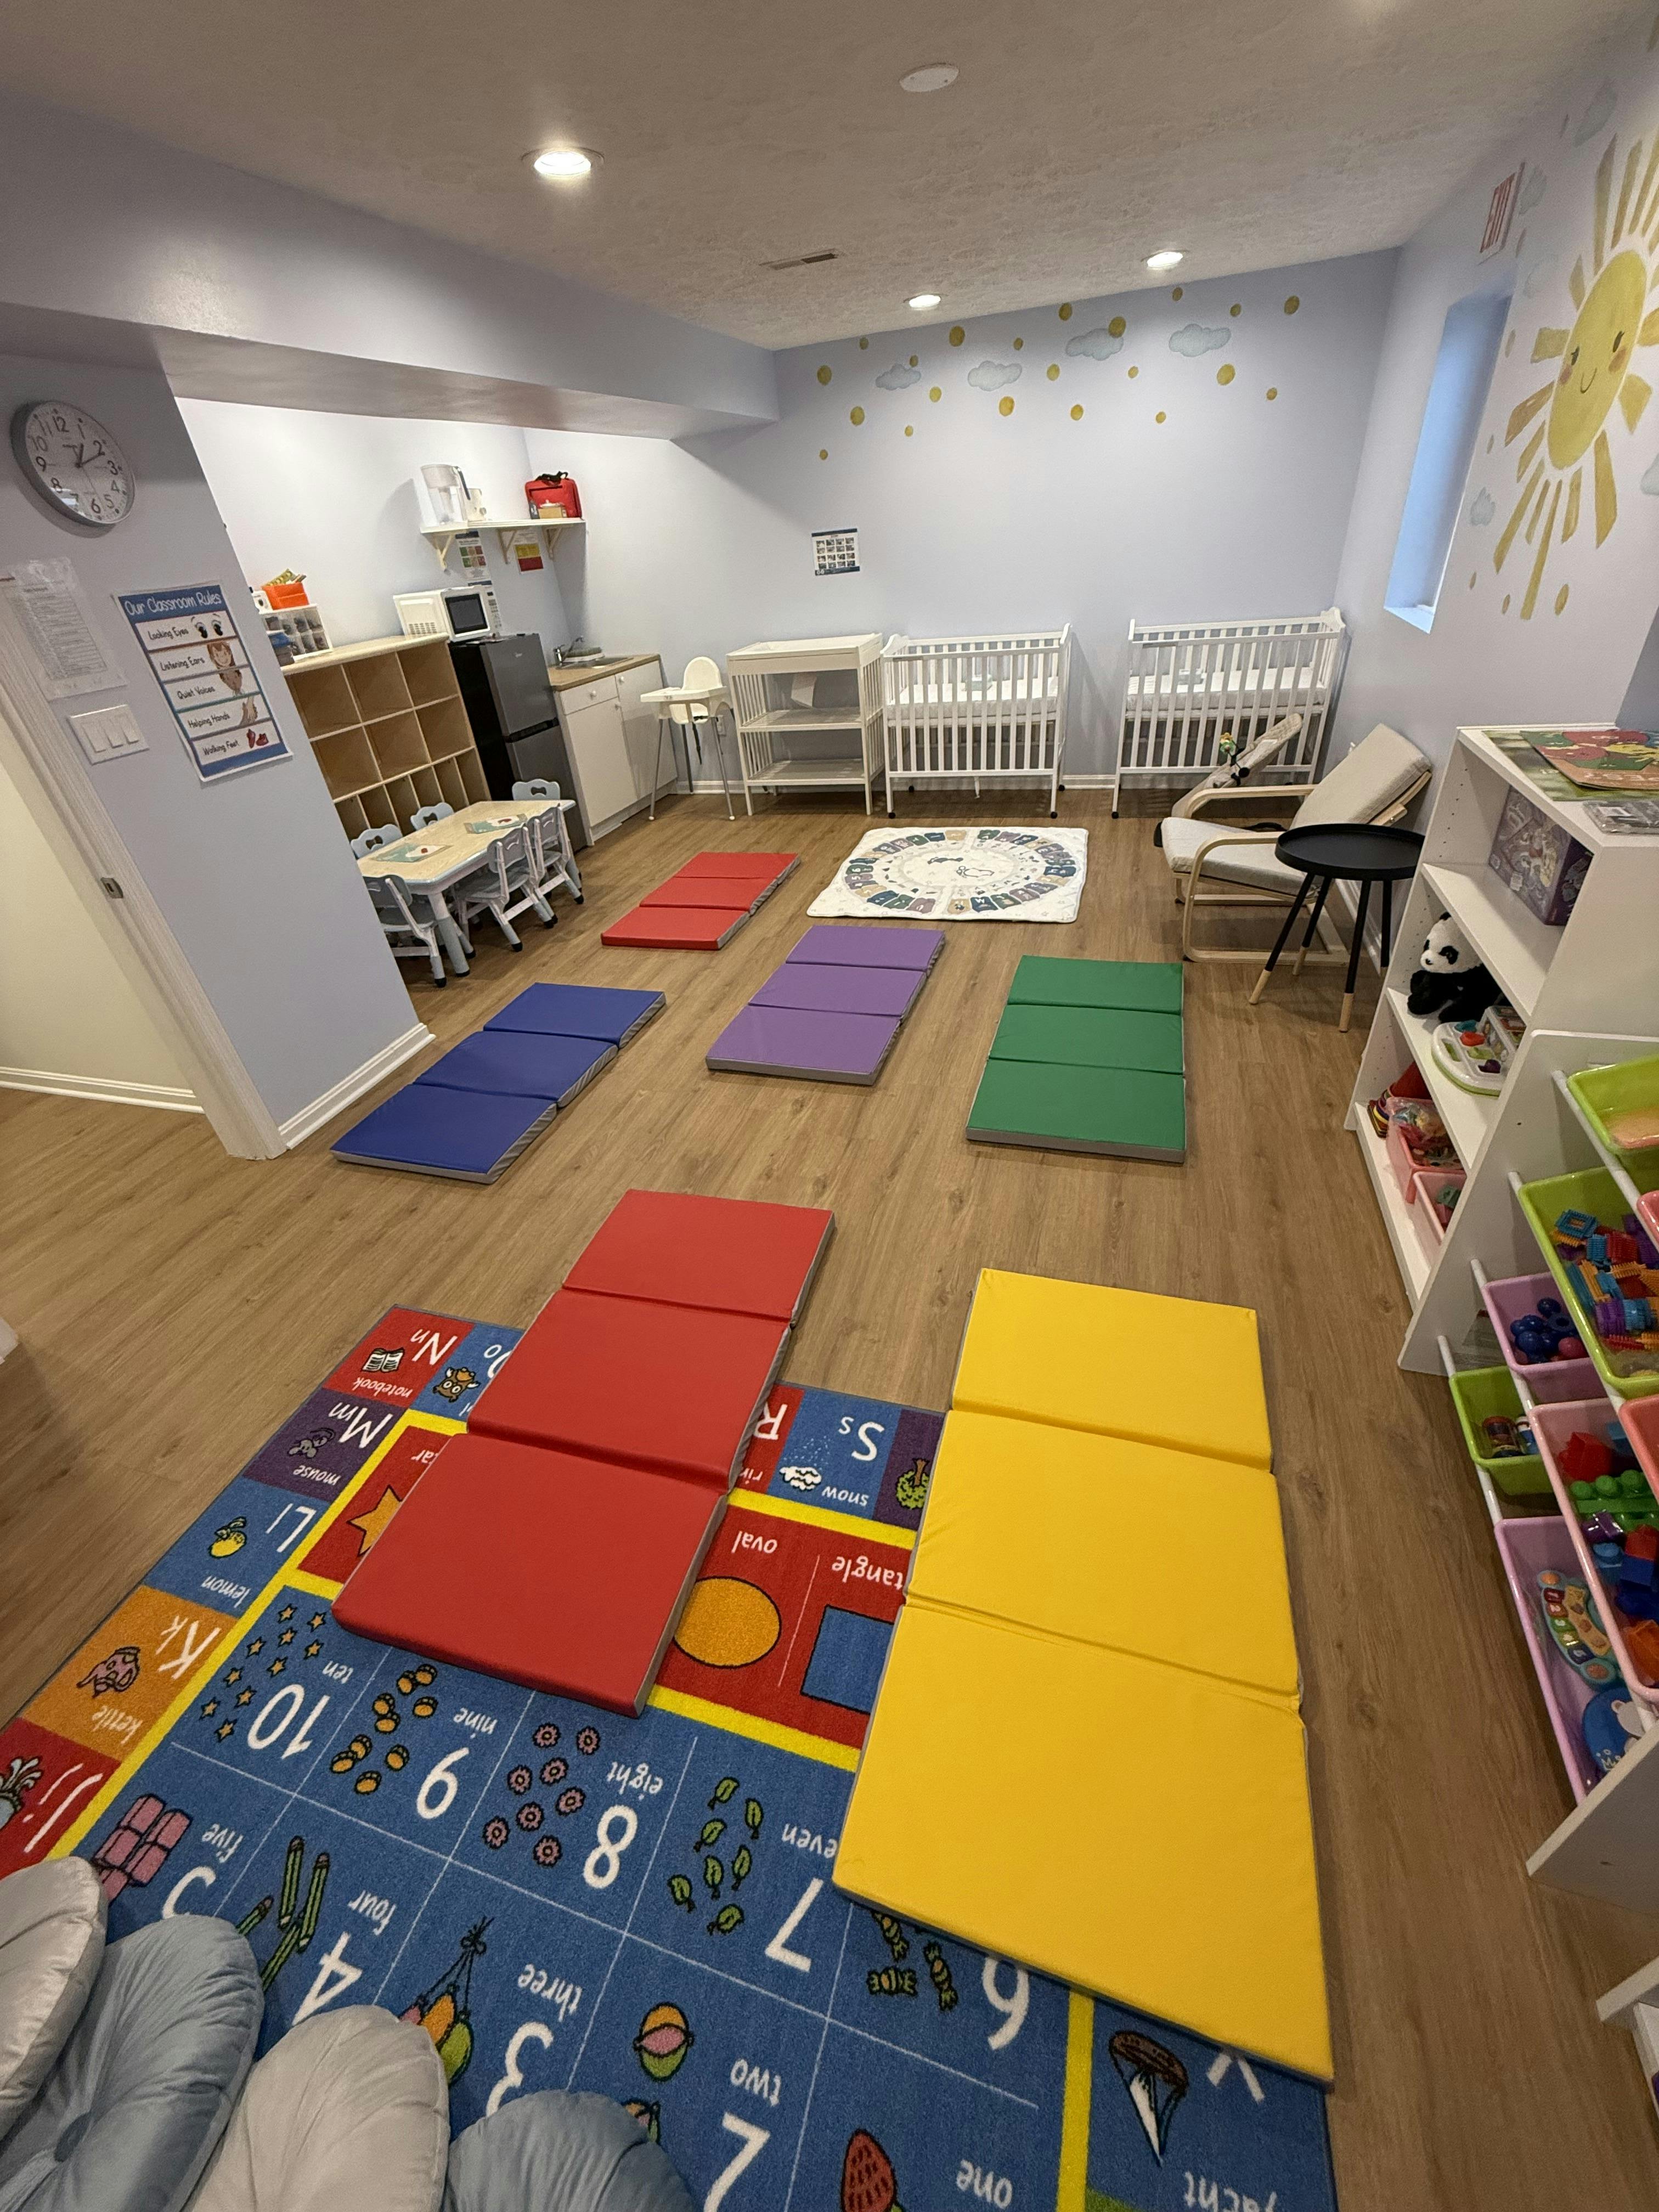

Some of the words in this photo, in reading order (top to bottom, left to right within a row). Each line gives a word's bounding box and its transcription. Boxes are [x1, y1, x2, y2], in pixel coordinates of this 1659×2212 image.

[38, 420, 54, 437] 11
[53, 415, 70, 433] 12
[77, 423, 86, 439] 1
[29, 436, 48, 453] 10
[93, 439, 105, 456] 2
[36, 456, 47, 472] 9
[107, 460, 119, 476] 3
[50, 477, 63, 494] 8
[111, 479, 121, 493] 4
[91, 498, 101, 514] 6
[103, 494, 114, 509] 5
[124, 600, 145, 616] Our
[146, 595, 198, 614] Classroom
[198, 591, 222, 605] Rules
[147, 628, 173, 640] Looking
[173, 627, 189, 638] Eyes
[159, 657, 189, 672] Listening
[188, 656, 205, 666] Ears
[177, 688, 195, 699] Quiet
[196, 685, 216, 695] Voices
[187, 716, 212, 730] Helping
[211, 712, 230, 724] Hands
[201, 743, 227, 756] Walking
[227, 740, 240, 751] Feet
[411, 1330, 457, 1365] Nn
[353, 1378, 413, 1397] notebook
[329, 1403, 393, 1448] Mm
[294, 1465, 340, 1485] mouse
[822, 1487, 868, 1506] snow
[732, 1531, 777, 1553] oval
[832, 1556, 903, 1589] tangle
[201, 1576, 250, 1608] lemon
[156, 1616, 220, 1679] Kk
[323, 1661, 353, 1684] ten
[92, 1706, 143, 1744] kettle
[248, 1685, 330, 1760] 10
[454, 1708, 497, 1738] nine
[416, 1748, 469, 1819] 9
[607, 1762, 663, 1800] eight
[202, 1824, 242, 1863] five
[583, 1805, 637, 1889] 8
[782, 1824, 837, 1858] even
[348, 1891, 396, 1935] four
[765, 1878, 823, 1972] 7
[292, 1932, 362, 2025] 4
[518, 1965, 582, 2024] three
[486, 2022, 553, 2116] 3
[731, 2059, 781, 2106] two
[956, 2159, 1012, 2209] one
